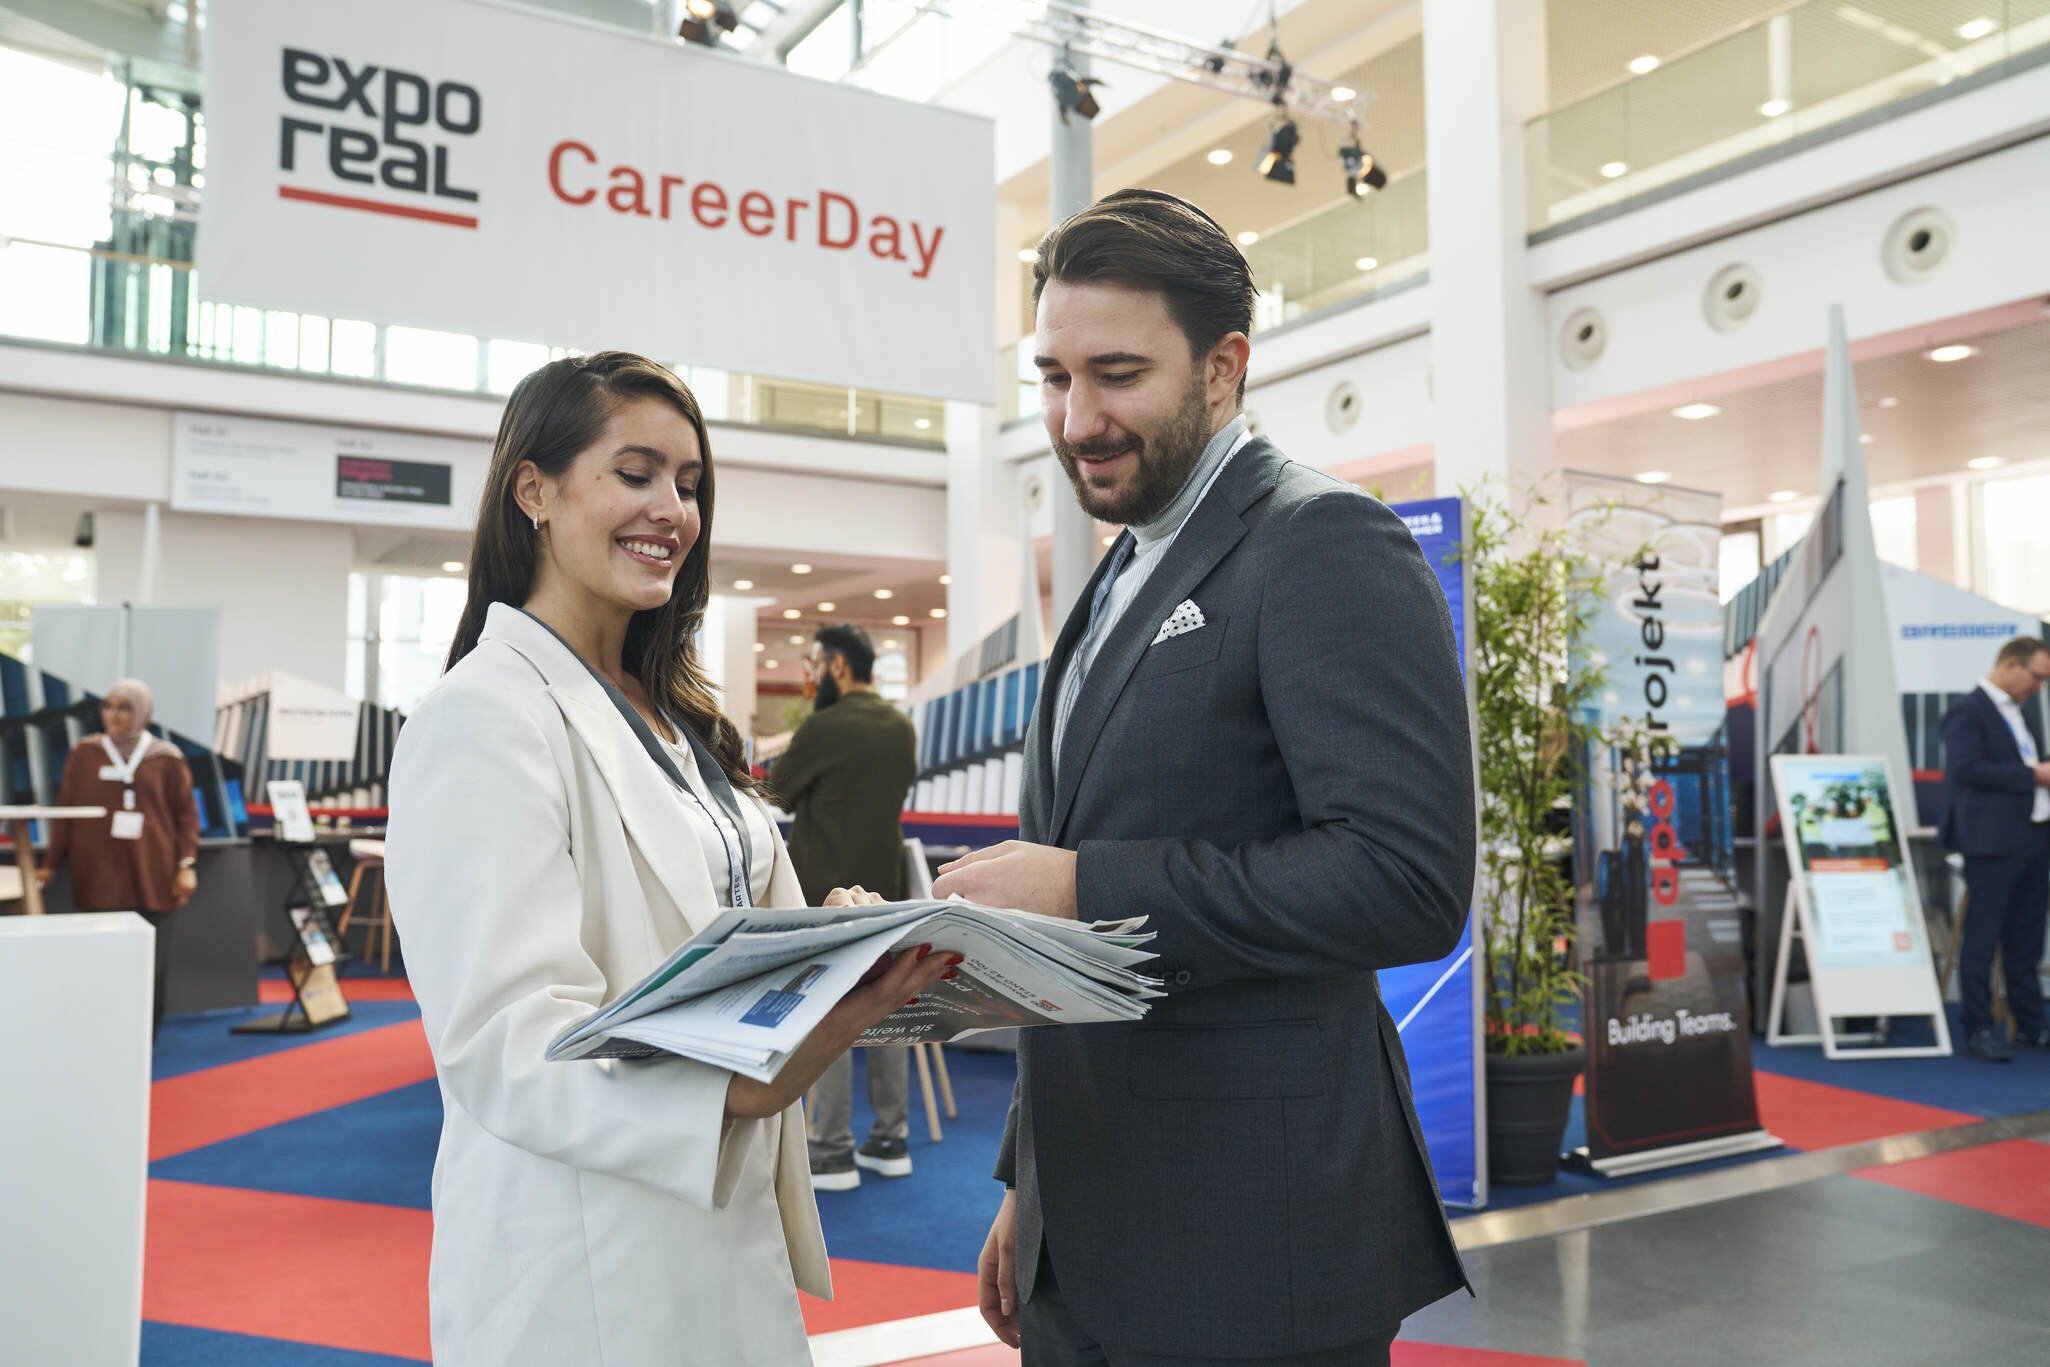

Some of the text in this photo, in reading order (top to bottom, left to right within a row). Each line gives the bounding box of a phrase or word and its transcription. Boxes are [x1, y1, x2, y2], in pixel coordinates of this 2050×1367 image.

[281, 47, 481, 145] expo
[547, 140, 946, 279] CareerDay
[860, 1024, 935, 1036] sie weite
[1608, 1008, 1737, 1046] Building Teams.
